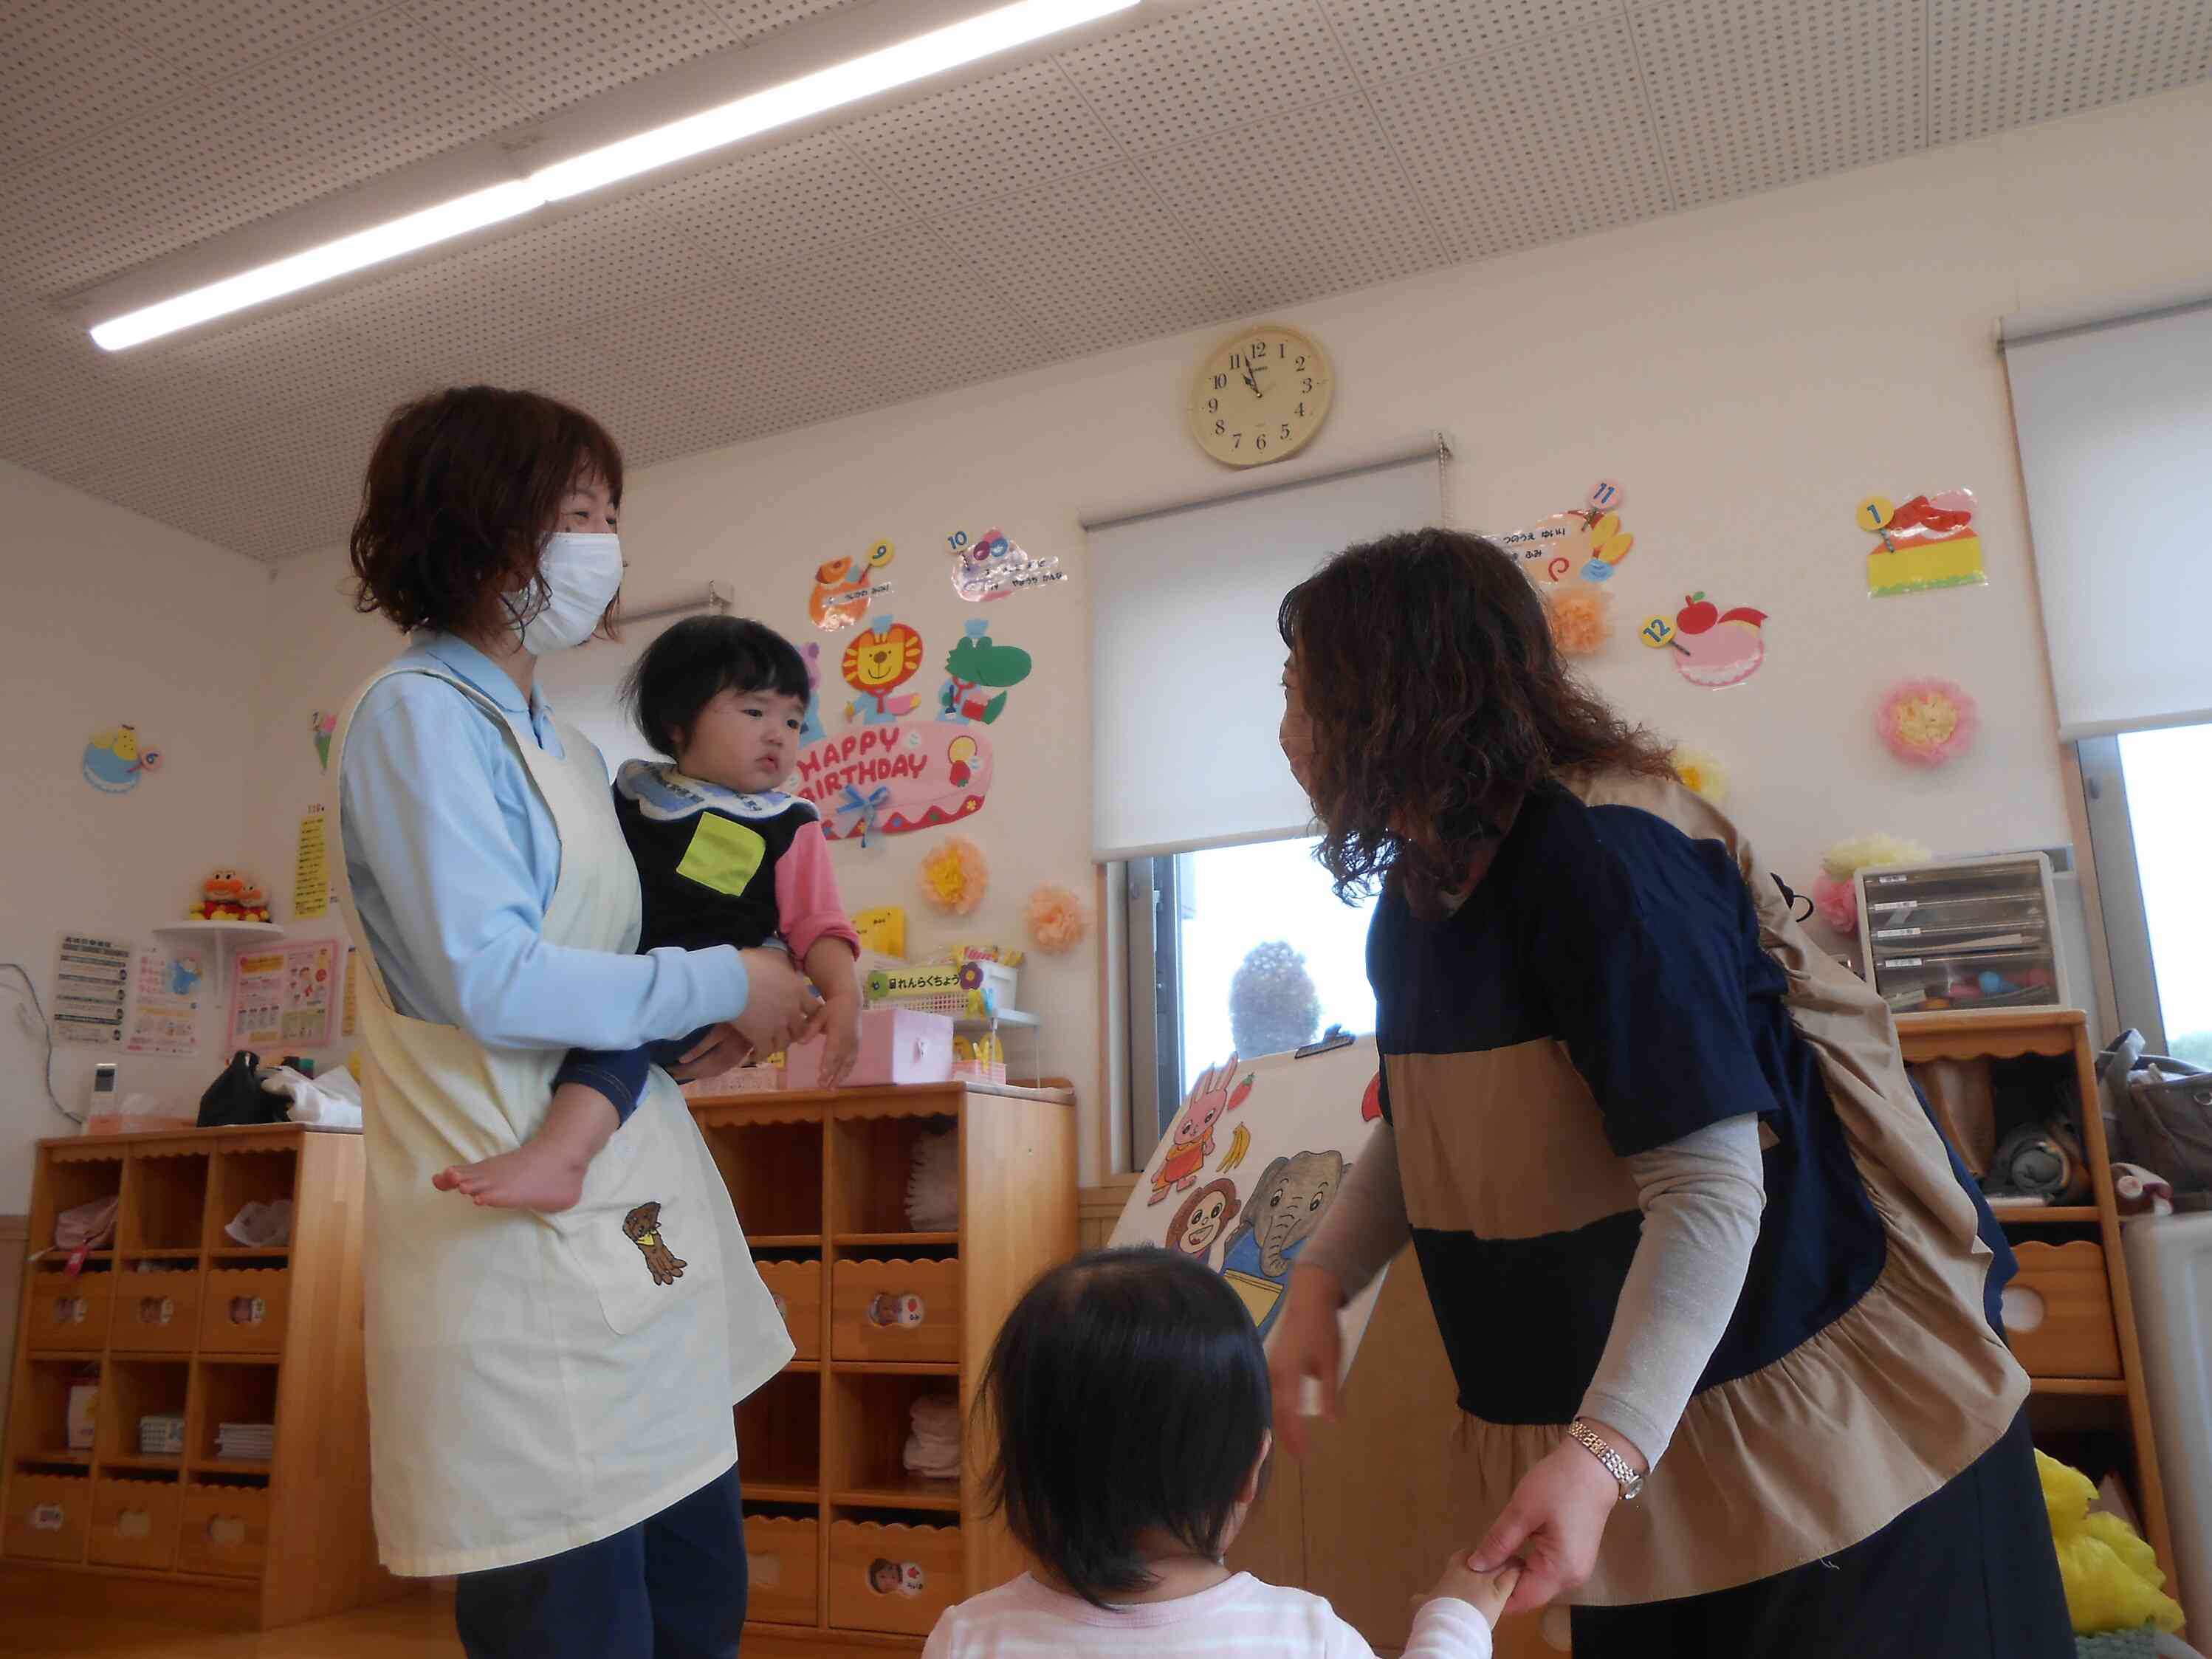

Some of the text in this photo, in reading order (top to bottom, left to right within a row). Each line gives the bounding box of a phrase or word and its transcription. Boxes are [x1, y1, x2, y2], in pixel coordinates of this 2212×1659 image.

[1251, 341, 1266, 359] 12
[1279, 343, 1285, 359] 1
[1229, 354, 1240, 370] 11
[1295, 355, 1305, 372] 2
[1212, 372, 1227, 390] 10
[1302, 377, 1313, 394] 3
[1208, 397, 1218, 413] 9
[1294, 401, 1305, 417] 4
[1215, 419, 1226, 435] 8
[1280, 423, 1291, 440] 5
[1232, 433, 1242, 449] 7
[1256, 433, 1267, 450] 6
[1593, 482, 1615, 504] 11
[1866, 504, 1881, 524] 1
[947, 530, 968, 550] 10
[872, 545, 887, 560] 9
[1642, 619, 1671, 642] 12
[797, 727, 900, 782] HAPPY
